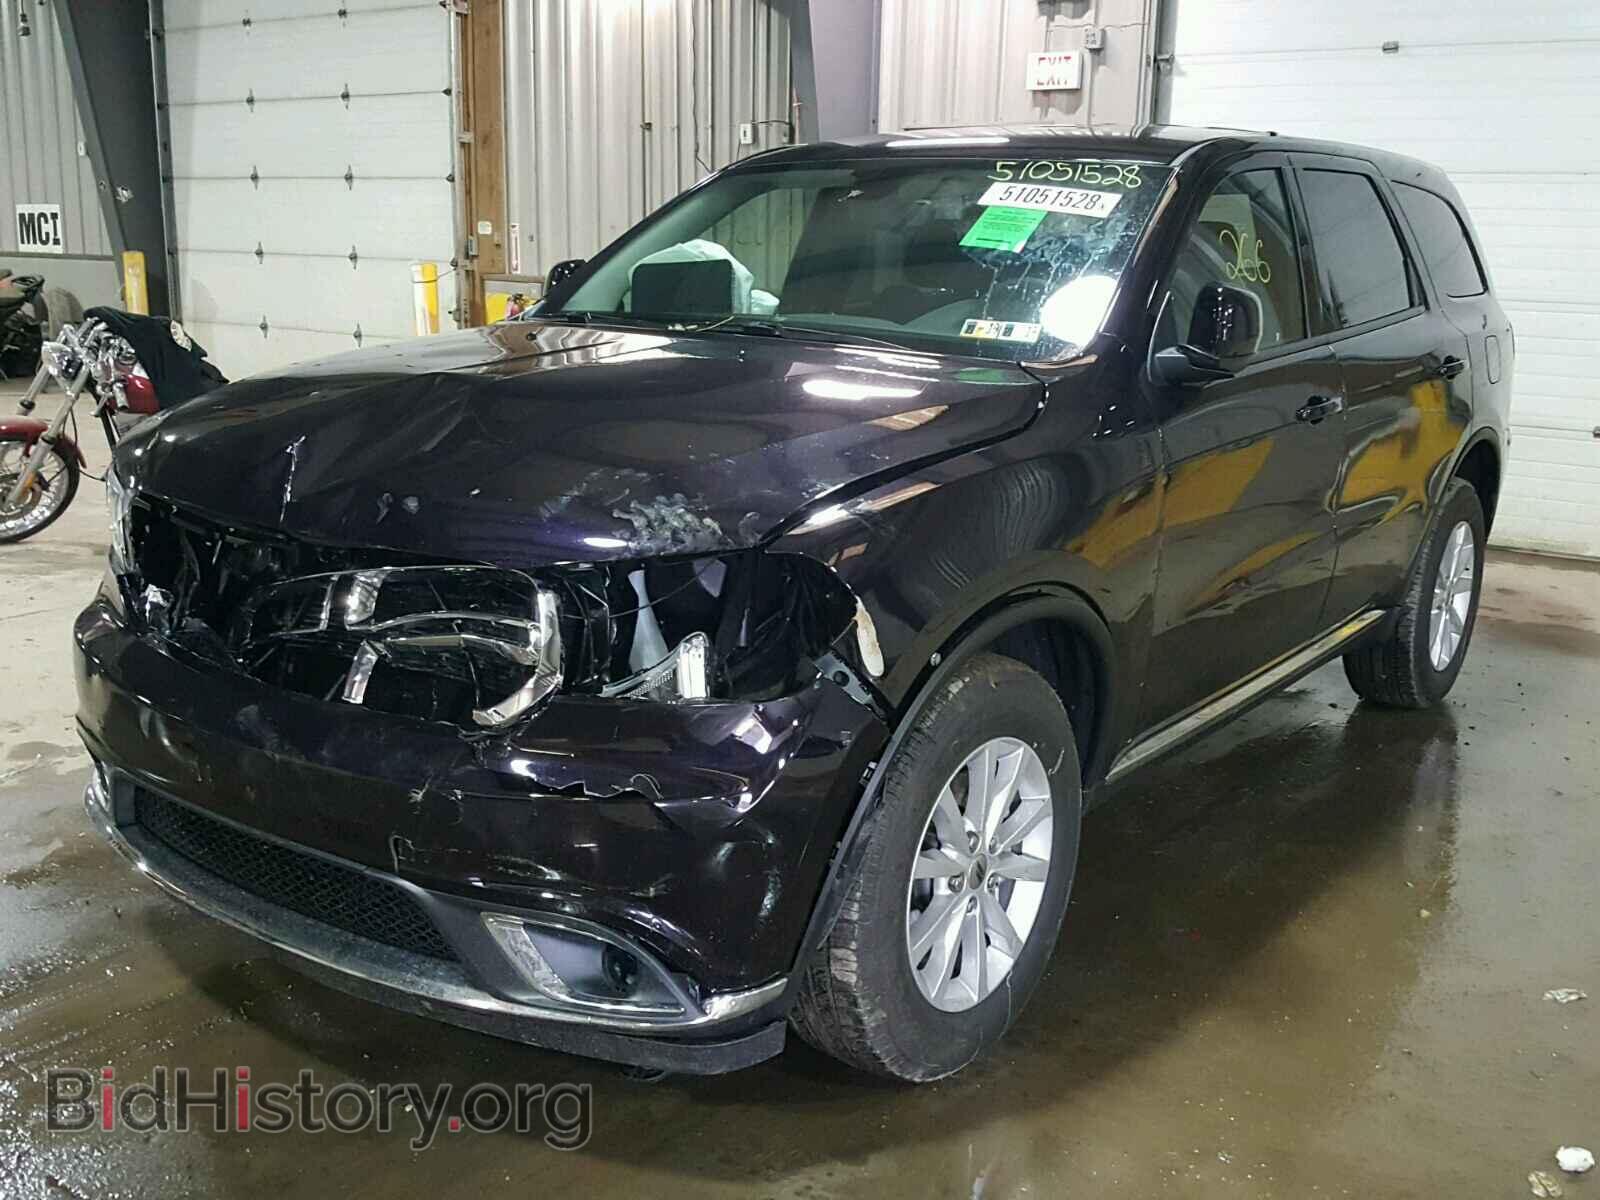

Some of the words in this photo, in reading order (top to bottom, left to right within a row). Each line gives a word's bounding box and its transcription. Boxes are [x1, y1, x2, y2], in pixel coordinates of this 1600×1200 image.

[987, 161, 1142, 188] 51051528
[1000, 185, 1102, 210] 51051528
[18, 212, 61, 245] MCI
